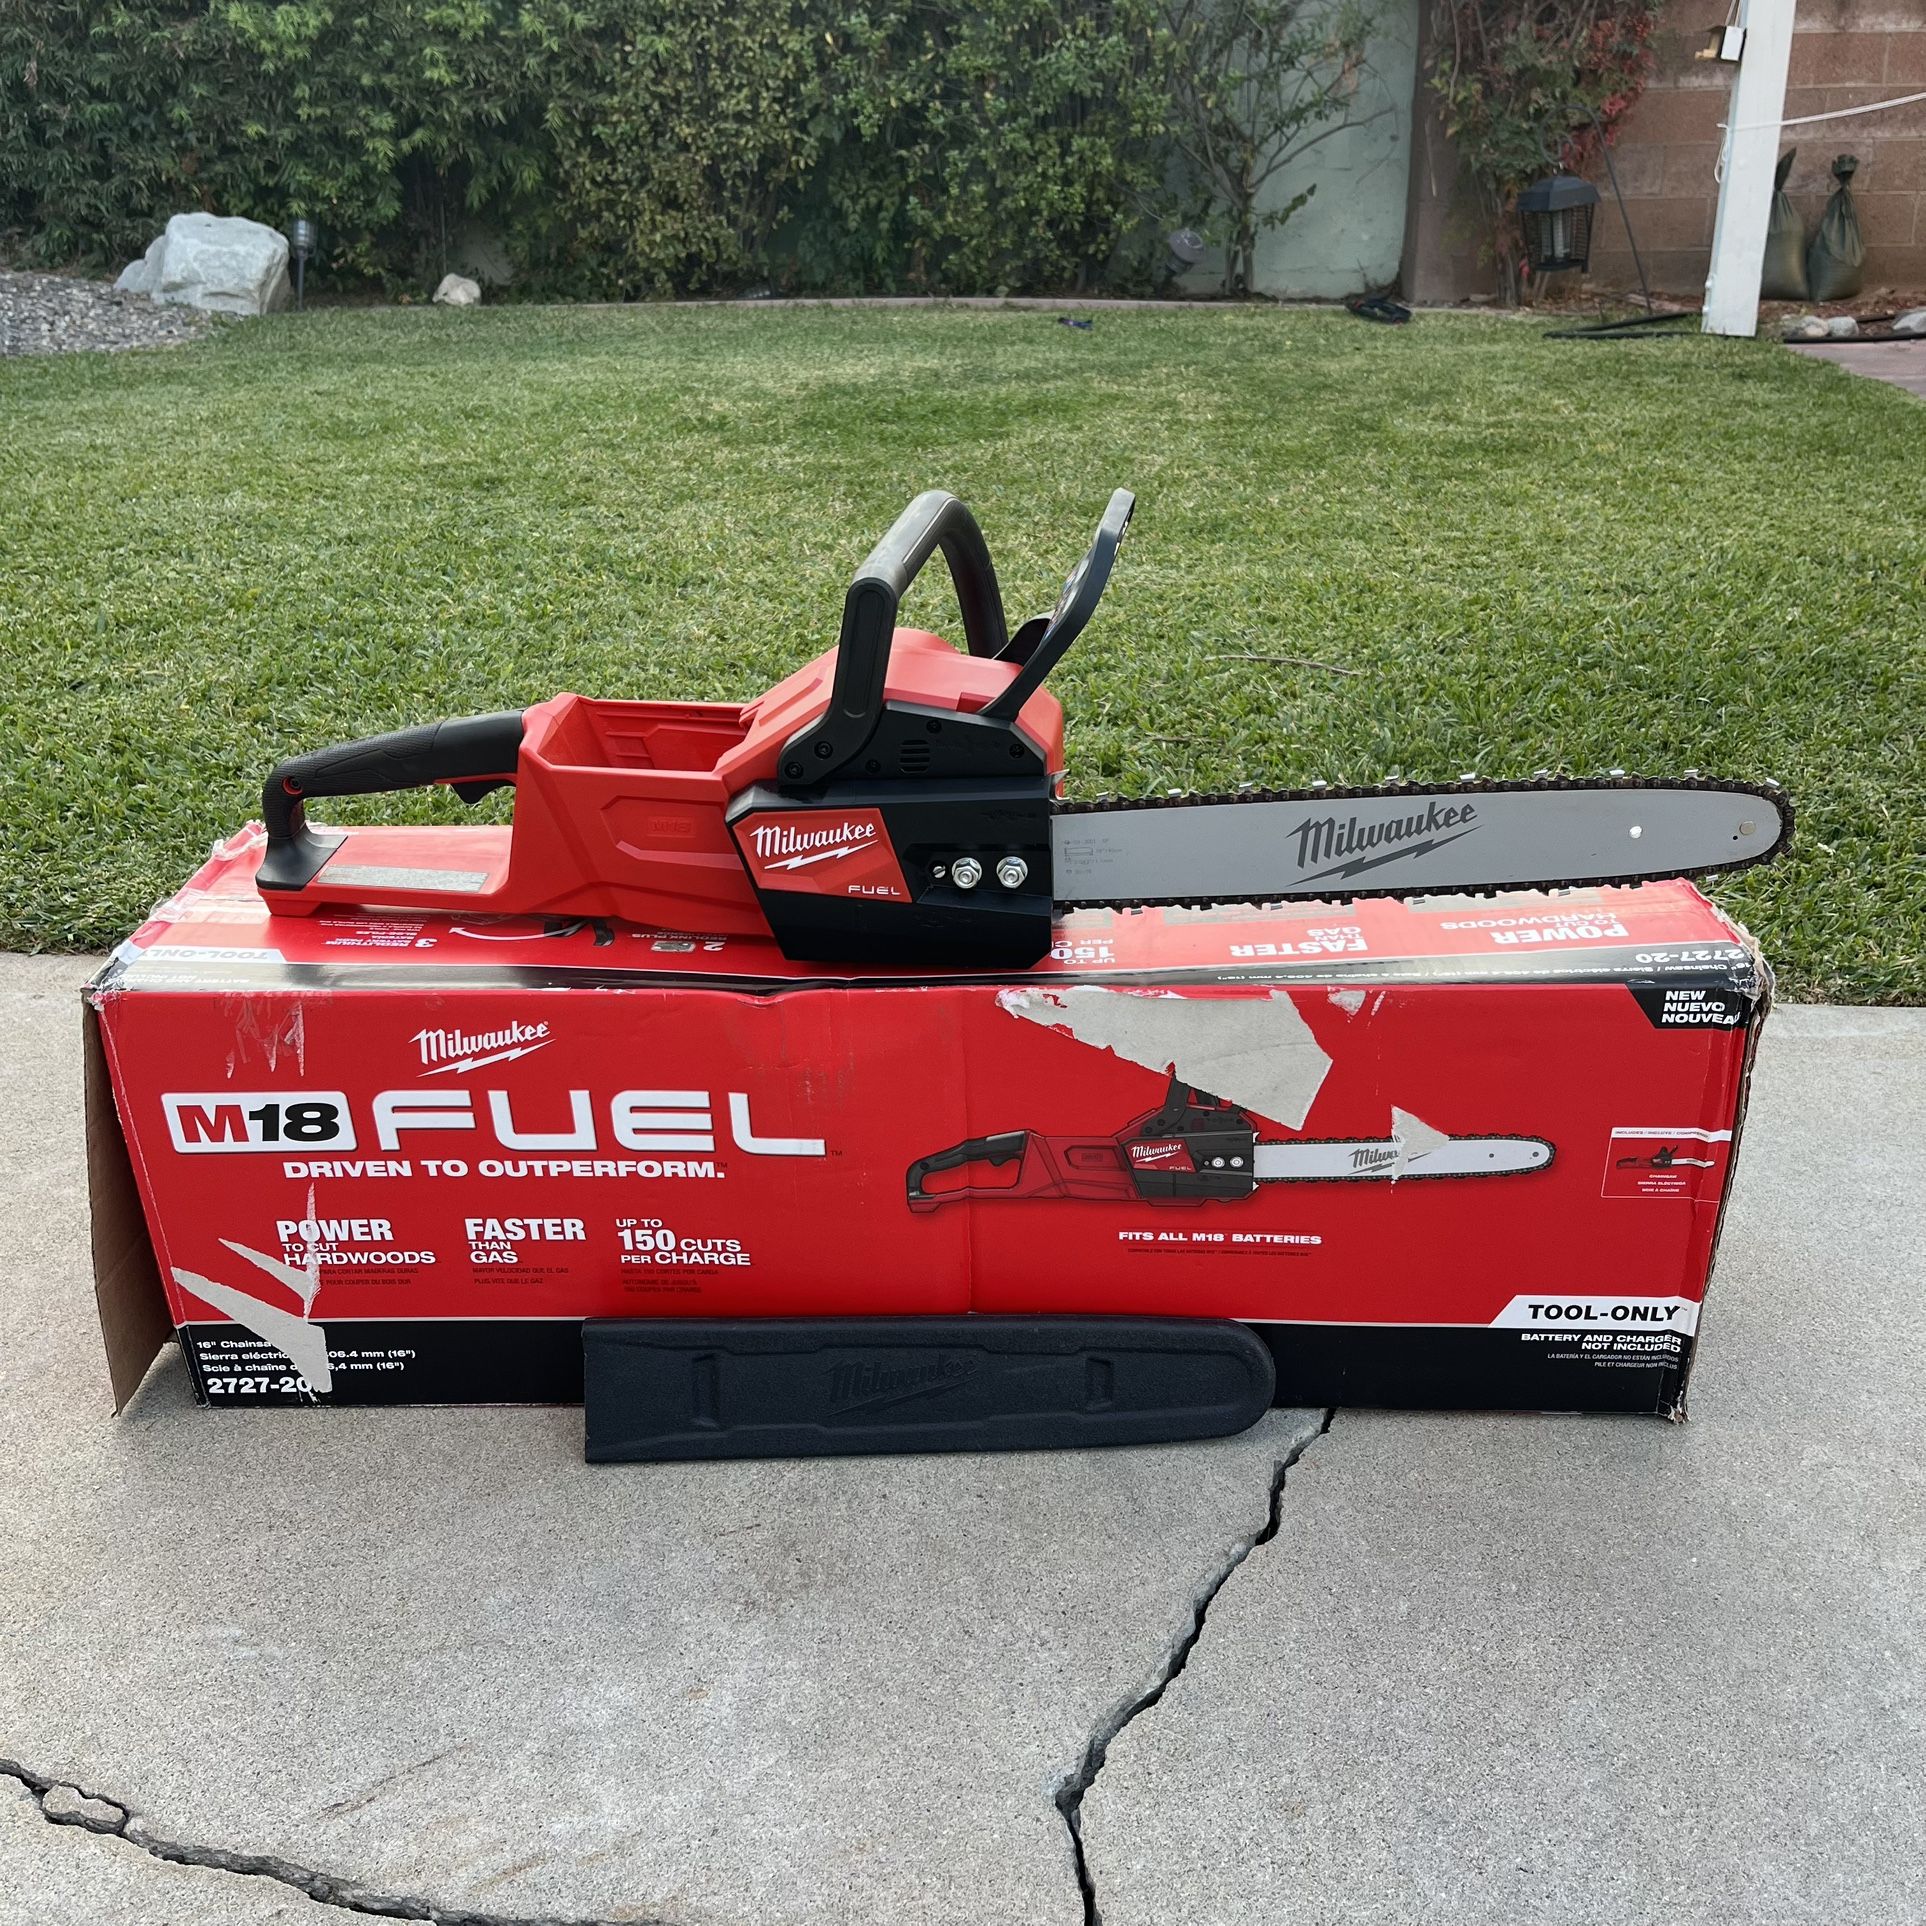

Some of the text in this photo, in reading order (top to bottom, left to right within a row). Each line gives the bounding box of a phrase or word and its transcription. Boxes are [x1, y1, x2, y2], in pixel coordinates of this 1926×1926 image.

[750, 822, 877, 858] Milwaukee
[1285, 801, 1479, 870] Milwaukee
[848, 885, 901, 895] FUEL
[1439, 912, 1617, 930] HARDWOODS
[1306, 926, 1362, 937] GAS
[1488, 923, 1630, 945] POWER
[1051, 946, 1115, 960] 150
[1228, 938, 1369, 957] FASTER
[1635, 948, 1746, 964] 2727-20
[1665, 964, 1728, 972] Chainsaw
[1665, 990, 1706, 1001] NEW
[1663, 1001, 1726, 1012] NUEVO
[408, 1020, 551, 1065] Milwaukee
[176, 1089, 826, 1156] M18 FUEL
[1131, 1143, 1182, 1158] Milwaukee
[283, 1159, 412, 1179] DRIVEN
[421, 1159, 469, 1178] TO
[464, 1218, 586, 1241] FASTER
[616, 1218, 663, 1228] UP TO
[276, 1219, 395, 1243] POWER
[1118, 1231, 1322, 1244] FITS ALL M18 BATTERIES
[282, 1243, 339, 1252] TO CUT
[468, 1241, 511, 1250] THAN
[617, 1228, 741, 1252] 150 CUTS
[283, 1251, 436, 1266] HARDWOODS
[469, 1251, 518, 1263] GAS
[620, 1251, 751, 1266] PER CHARGE
[1528, 1304, 1680, 1322] TOOL-ONLY
[197, 1340, 272, 1349] 16" Chainsa
[1521, 1333, 1682, 1345] BATTERY AND CHARGER
[199, 1352, 238, 1360] Sierra
[242, 1351, 290, 1360] eléctric
[388, 1350, 416, 1359] (16")
[1581, 1342, 1681, 1353] NOT INCLUDED
[203, 1364, 231, 1372] Scie
[234, 1364, 242, 1372] à
[245, 1363, 287, 1371] chaîne
[377, 1362, 404, 1371] (16")
[207, 1376, 313, 1393] 2727-20
